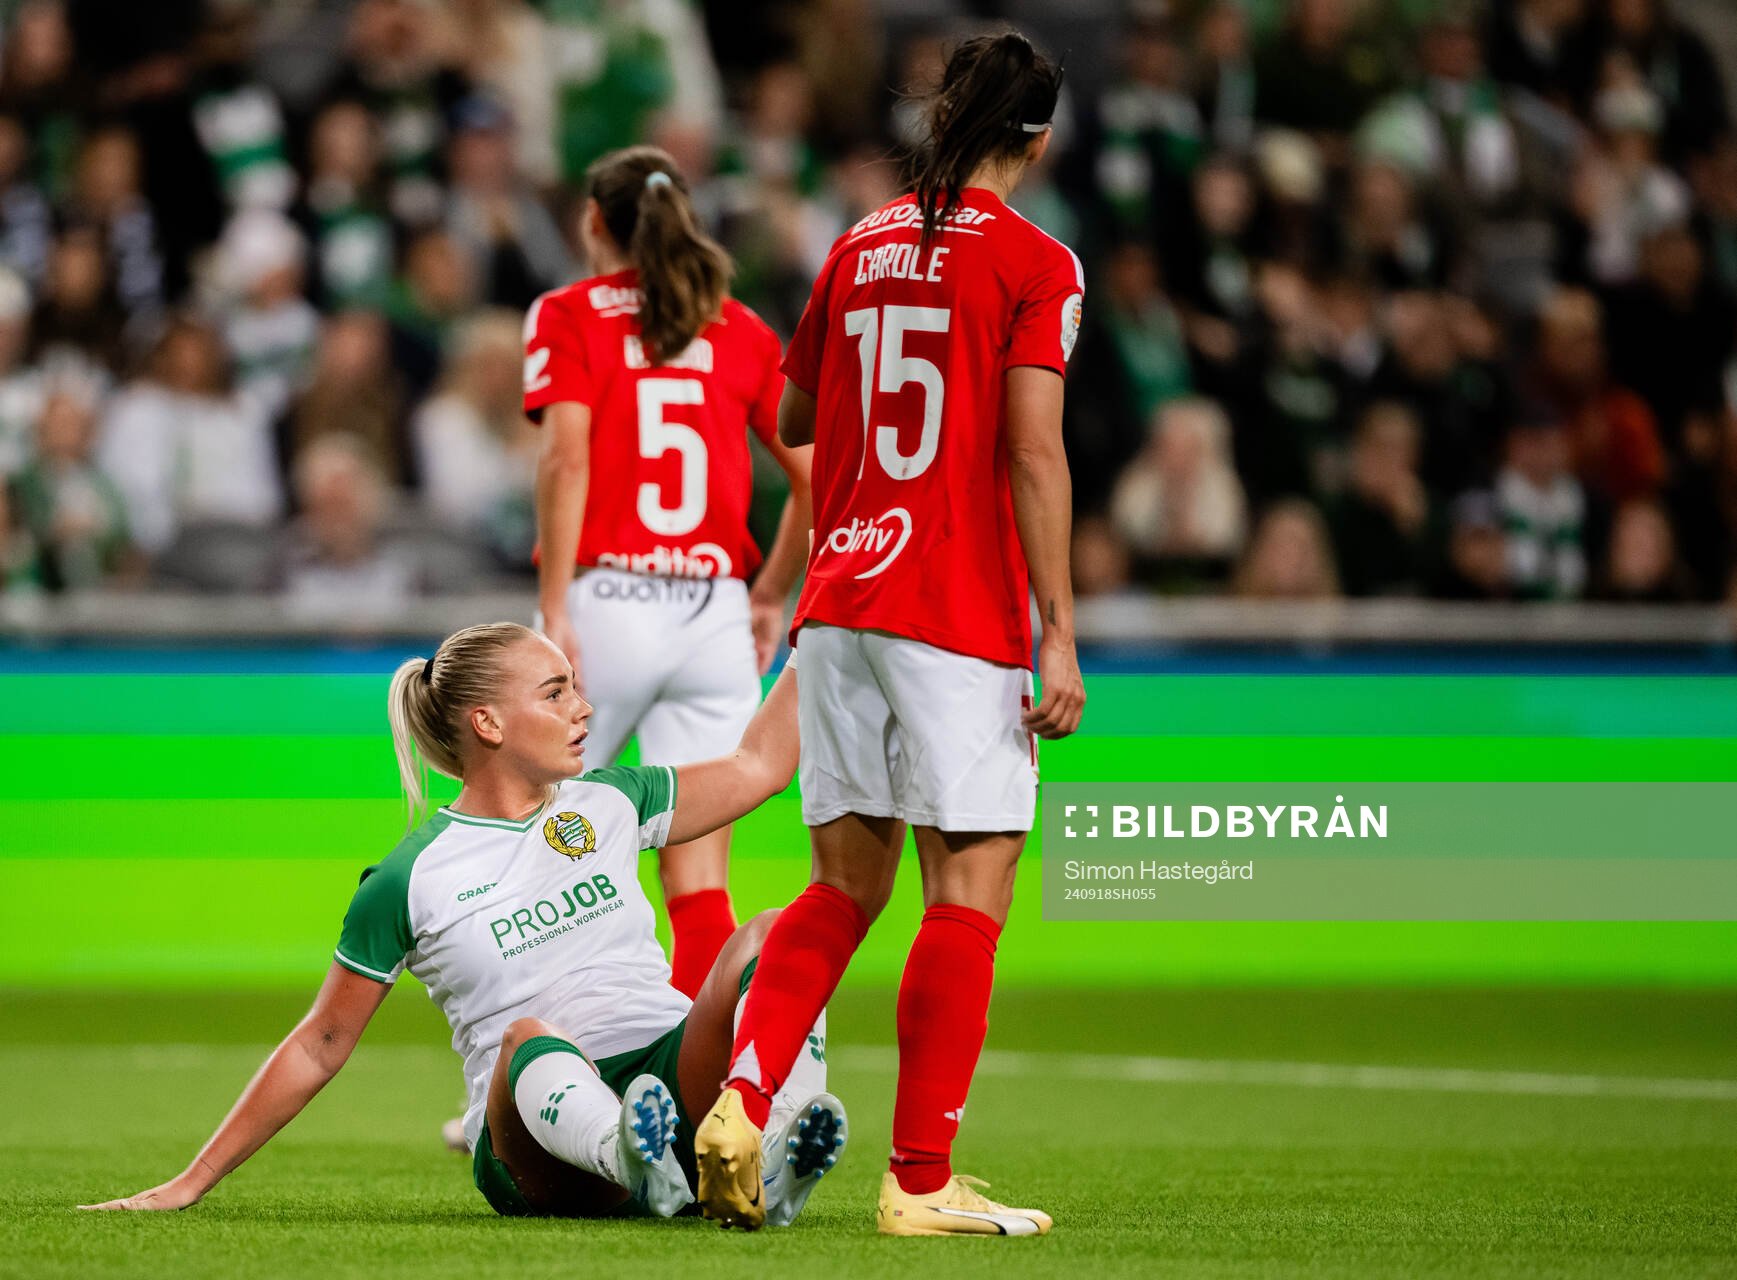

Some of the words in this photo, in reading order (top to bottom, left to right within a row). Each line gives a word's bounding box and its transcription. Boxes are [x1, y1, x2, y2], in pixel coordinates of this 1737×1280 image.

[854, 243, 951, 286] CAROLE
[845, 304, 951, 481] 15
[636, 377, 708, 537] 5
[819, 516, 895, 556] ditiv
[489, 873, 618, 949] PROJOB
[502, 922, 575, 960] PROFESSIONAL
[573, 899, 625, 928] WORKWEAR
